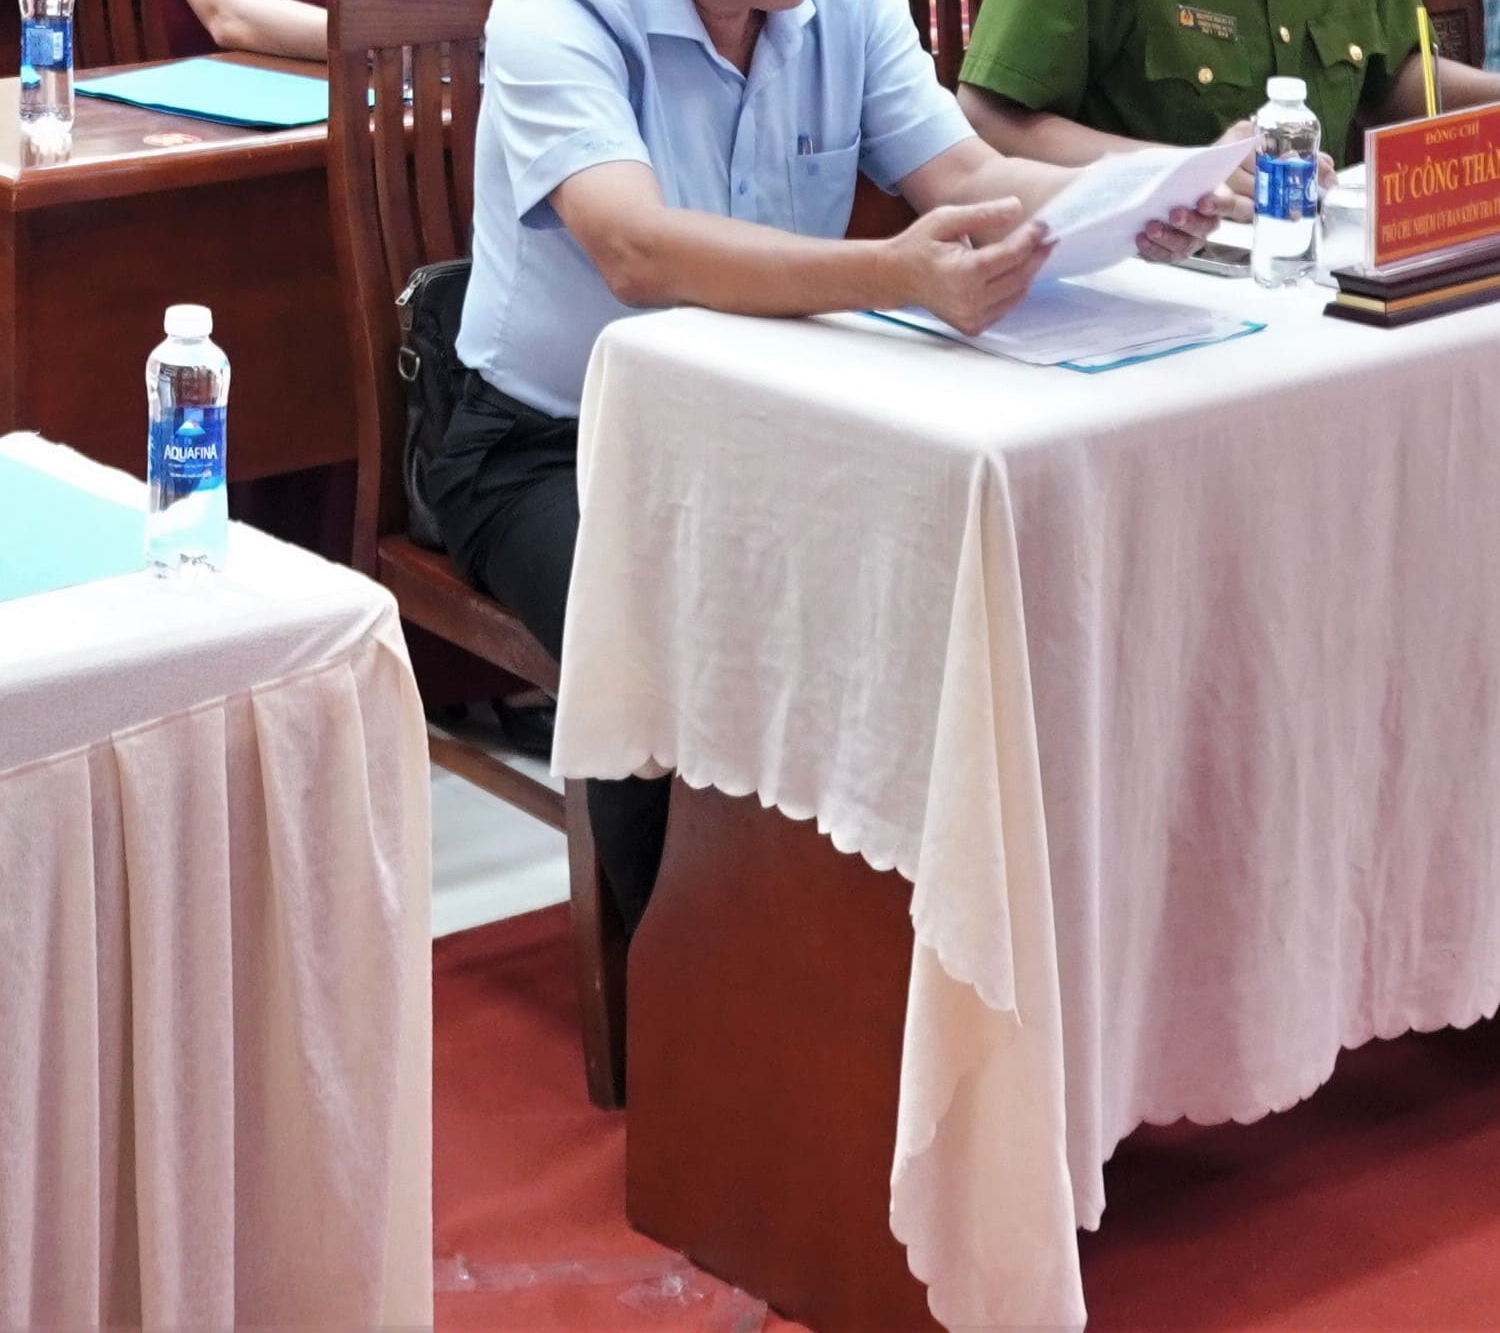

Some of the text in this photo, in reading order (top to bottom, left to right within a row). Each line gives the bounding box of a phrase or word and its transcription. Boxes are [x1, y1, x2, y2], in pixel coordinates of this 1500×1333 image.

[1424, 119, 1480, 145] ĐỒNG CHÍ
[1383, 161, 1409, 205] TỪ
[1410, 155, 1459, 198] CÔNG
[163, 443, 218, 463] AQUAFINA
